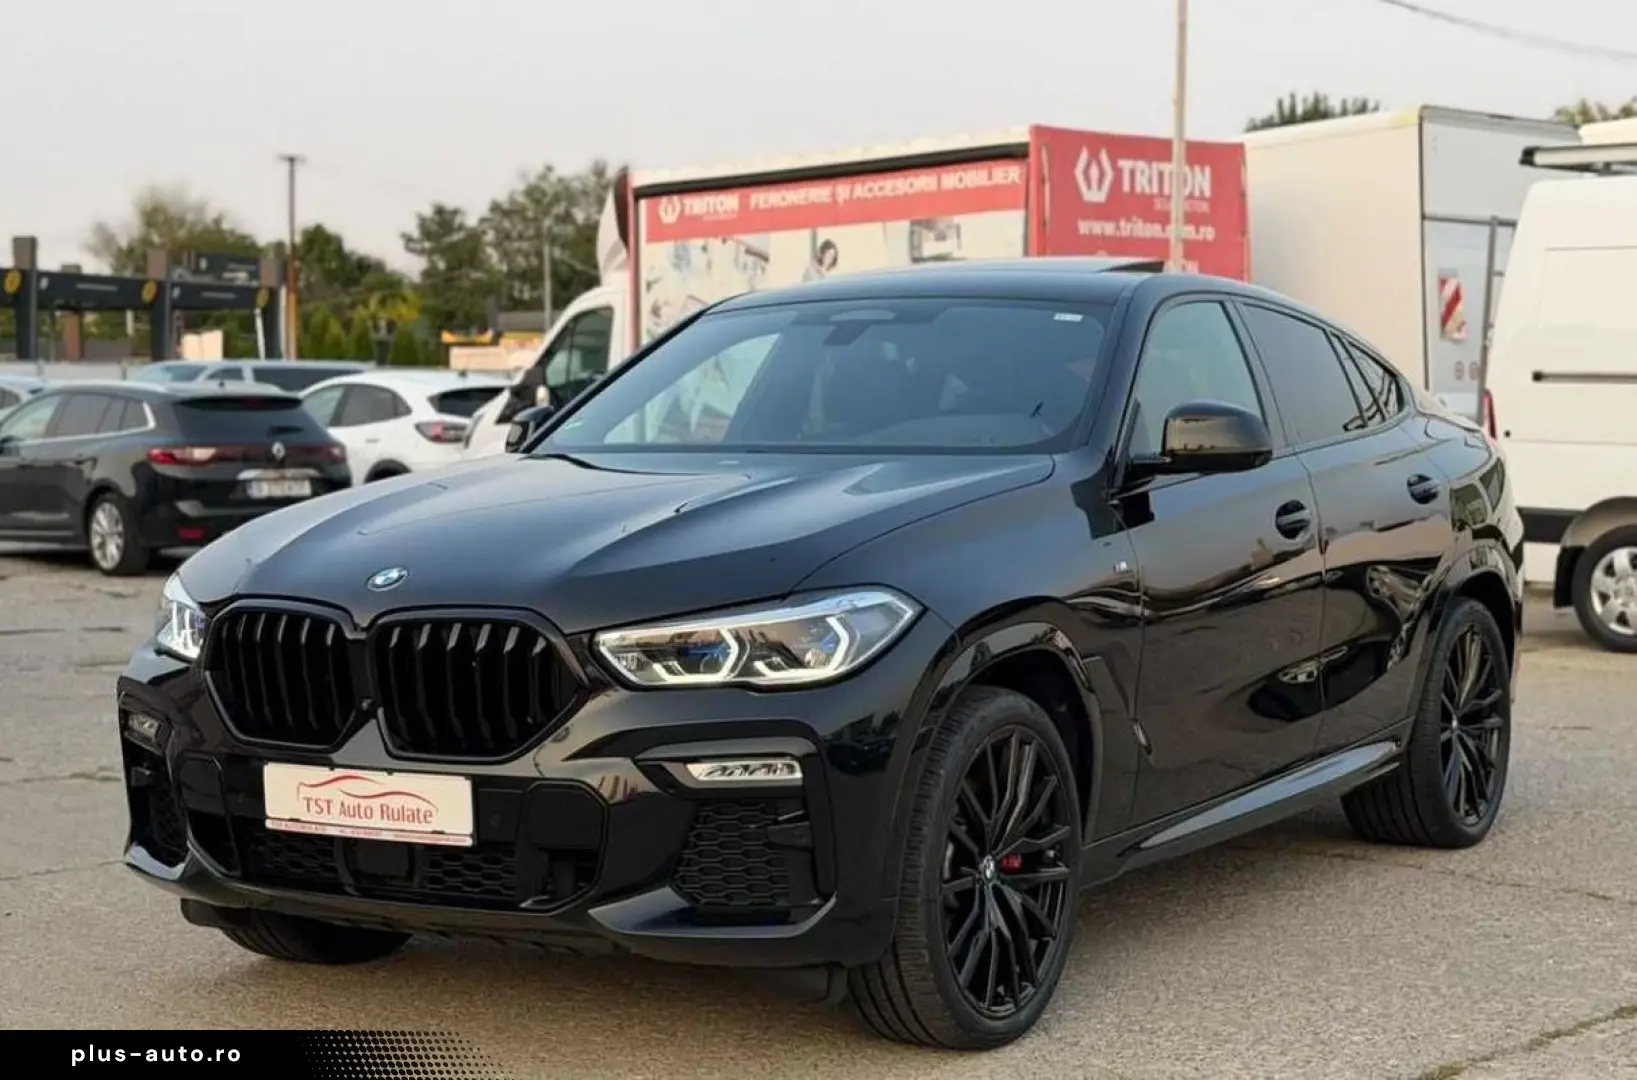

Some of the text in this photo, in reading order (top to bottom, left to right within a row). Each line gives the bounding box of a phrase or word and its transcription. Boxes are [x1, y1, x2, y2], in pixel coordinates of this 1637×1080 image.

[852, 175, 939, 200] ACCESORII
[941, 166, 1020, 192] MOBILIER
[683, 193, 739, 216] TRITON
[1077, 215, 1216, 242] www.triton.cm.ro
[302, 796, 433, 824] TST Auto Rulate
